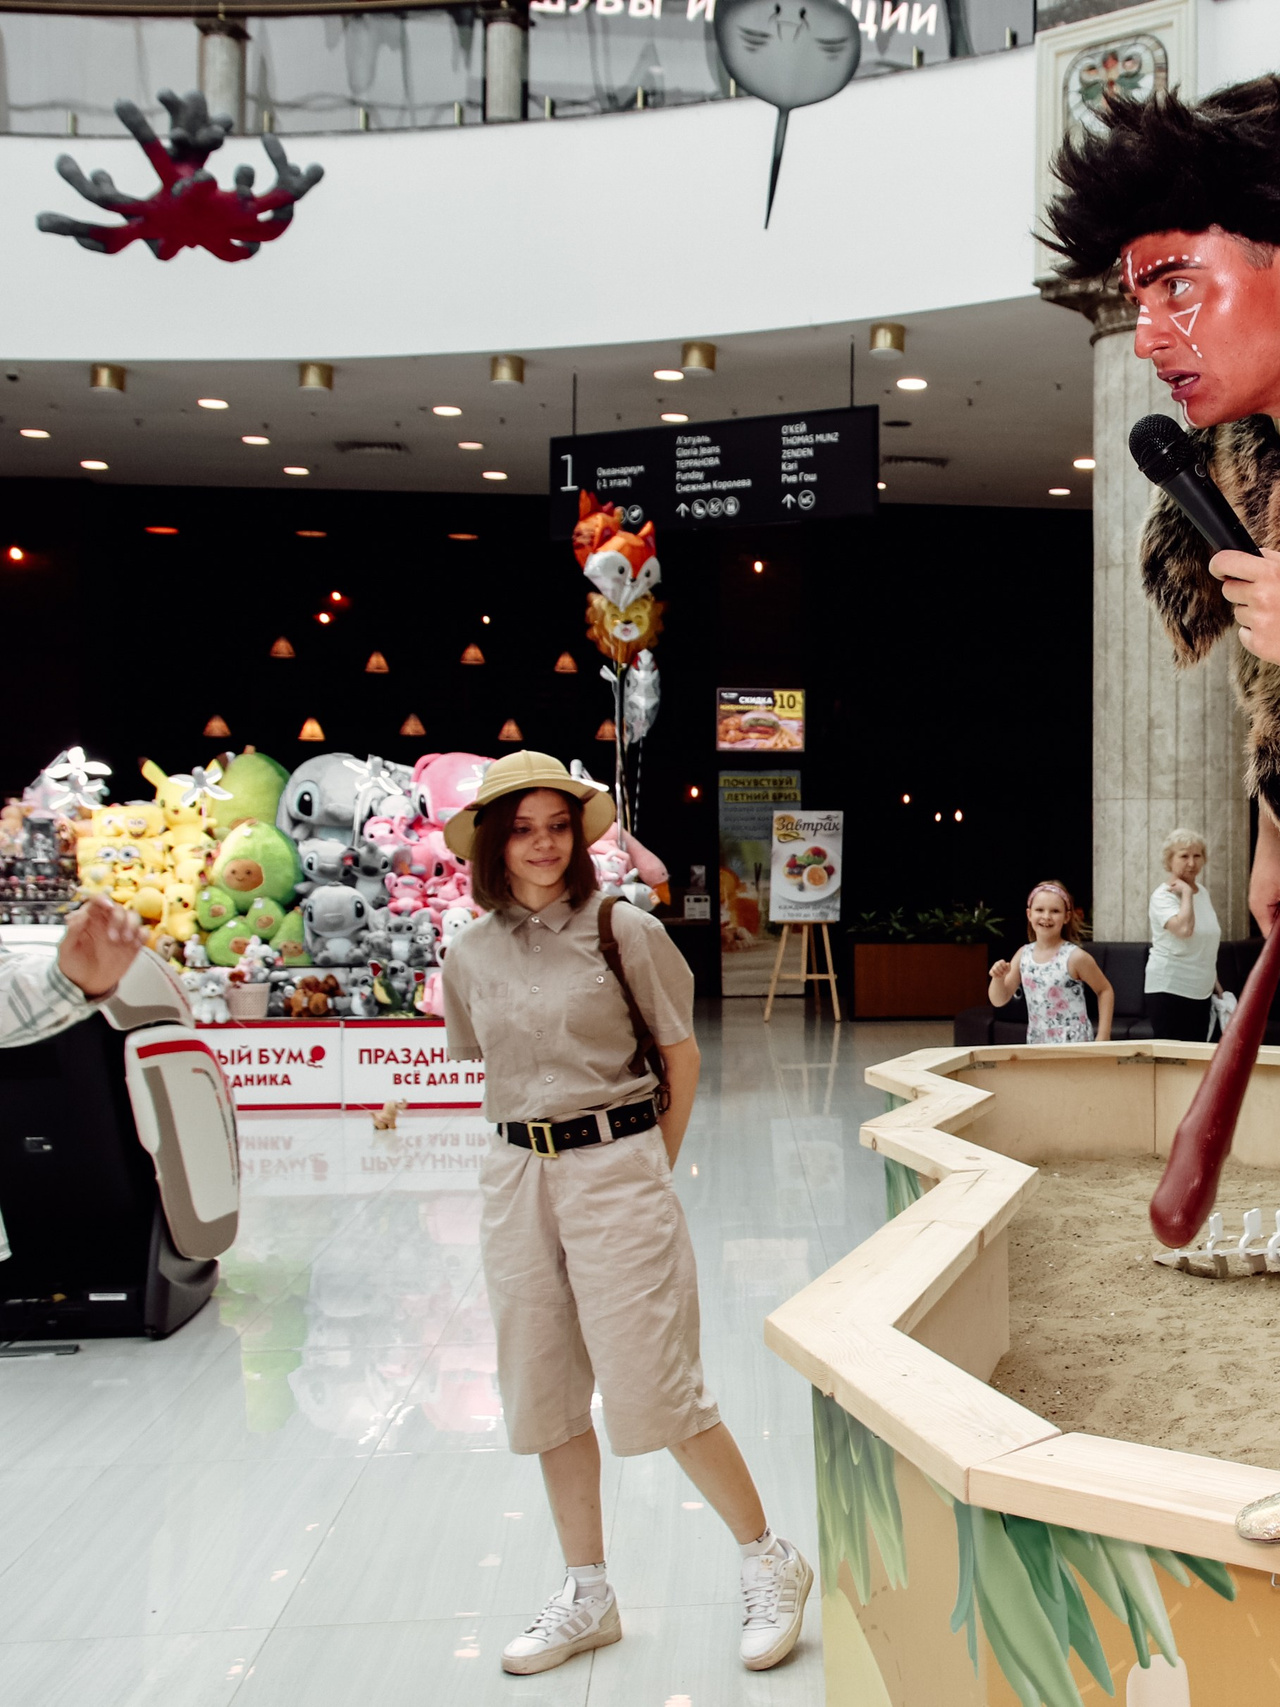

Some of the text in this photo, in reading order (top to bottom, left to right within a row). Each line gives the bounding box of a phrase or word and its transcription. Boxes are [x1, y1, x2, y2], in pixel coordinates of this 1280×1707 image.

[842, 0, 938, 41] ЦИИ
[782, 447, 814, 459] ZENDEN
[561, 454, 579, 491] 1
[597, 465, 645, 478] Океанариум
[676, 470, 704, 482] Funday
[799, 472, 817, 482] Гош
[676, 479, 752, 494] Снежная Королева
[779, 693, 796, 709] 10
[723, 777, 793, 787] ПОЧУВСТВУЙ
[727, 791, 769, 801] ЛЕТНИЙ
[776, 817, 840, 837] Завтрак
[217, 1045, 305, 1065] ЫЙ БУМ
[230, 1074, 292, 1088] ДНИКА
[393, 1070, 421, 1085] ВСЁ
[426, 1072, 459, 1086] ДЛЯ
